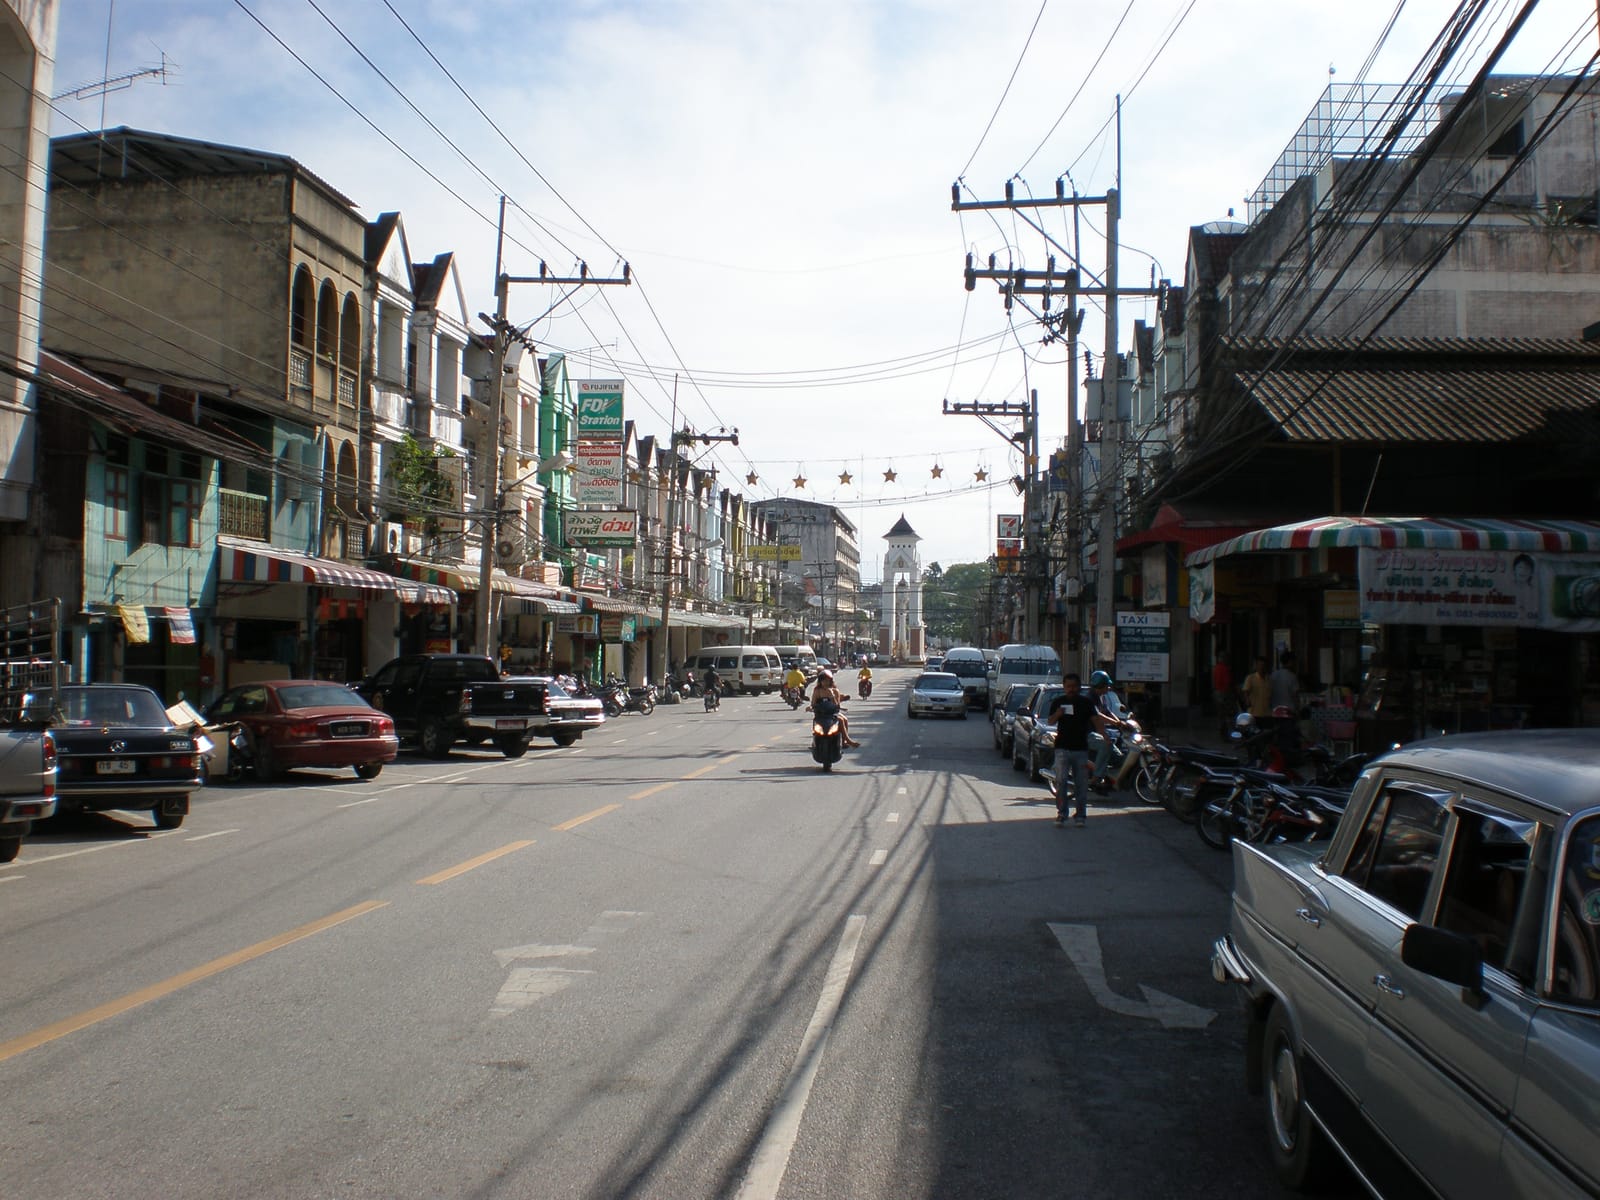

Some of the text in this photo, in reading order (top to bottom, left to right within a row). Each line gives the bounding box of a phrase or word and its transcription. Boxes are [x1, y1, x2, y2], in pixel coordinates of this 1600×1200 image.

[579, 415, 620, 425] Station
[602, 517, 633, 532] ด่วน
[1432, 576, 1449, 587] 24
[1120, 615, 1148, 625] TAXI
